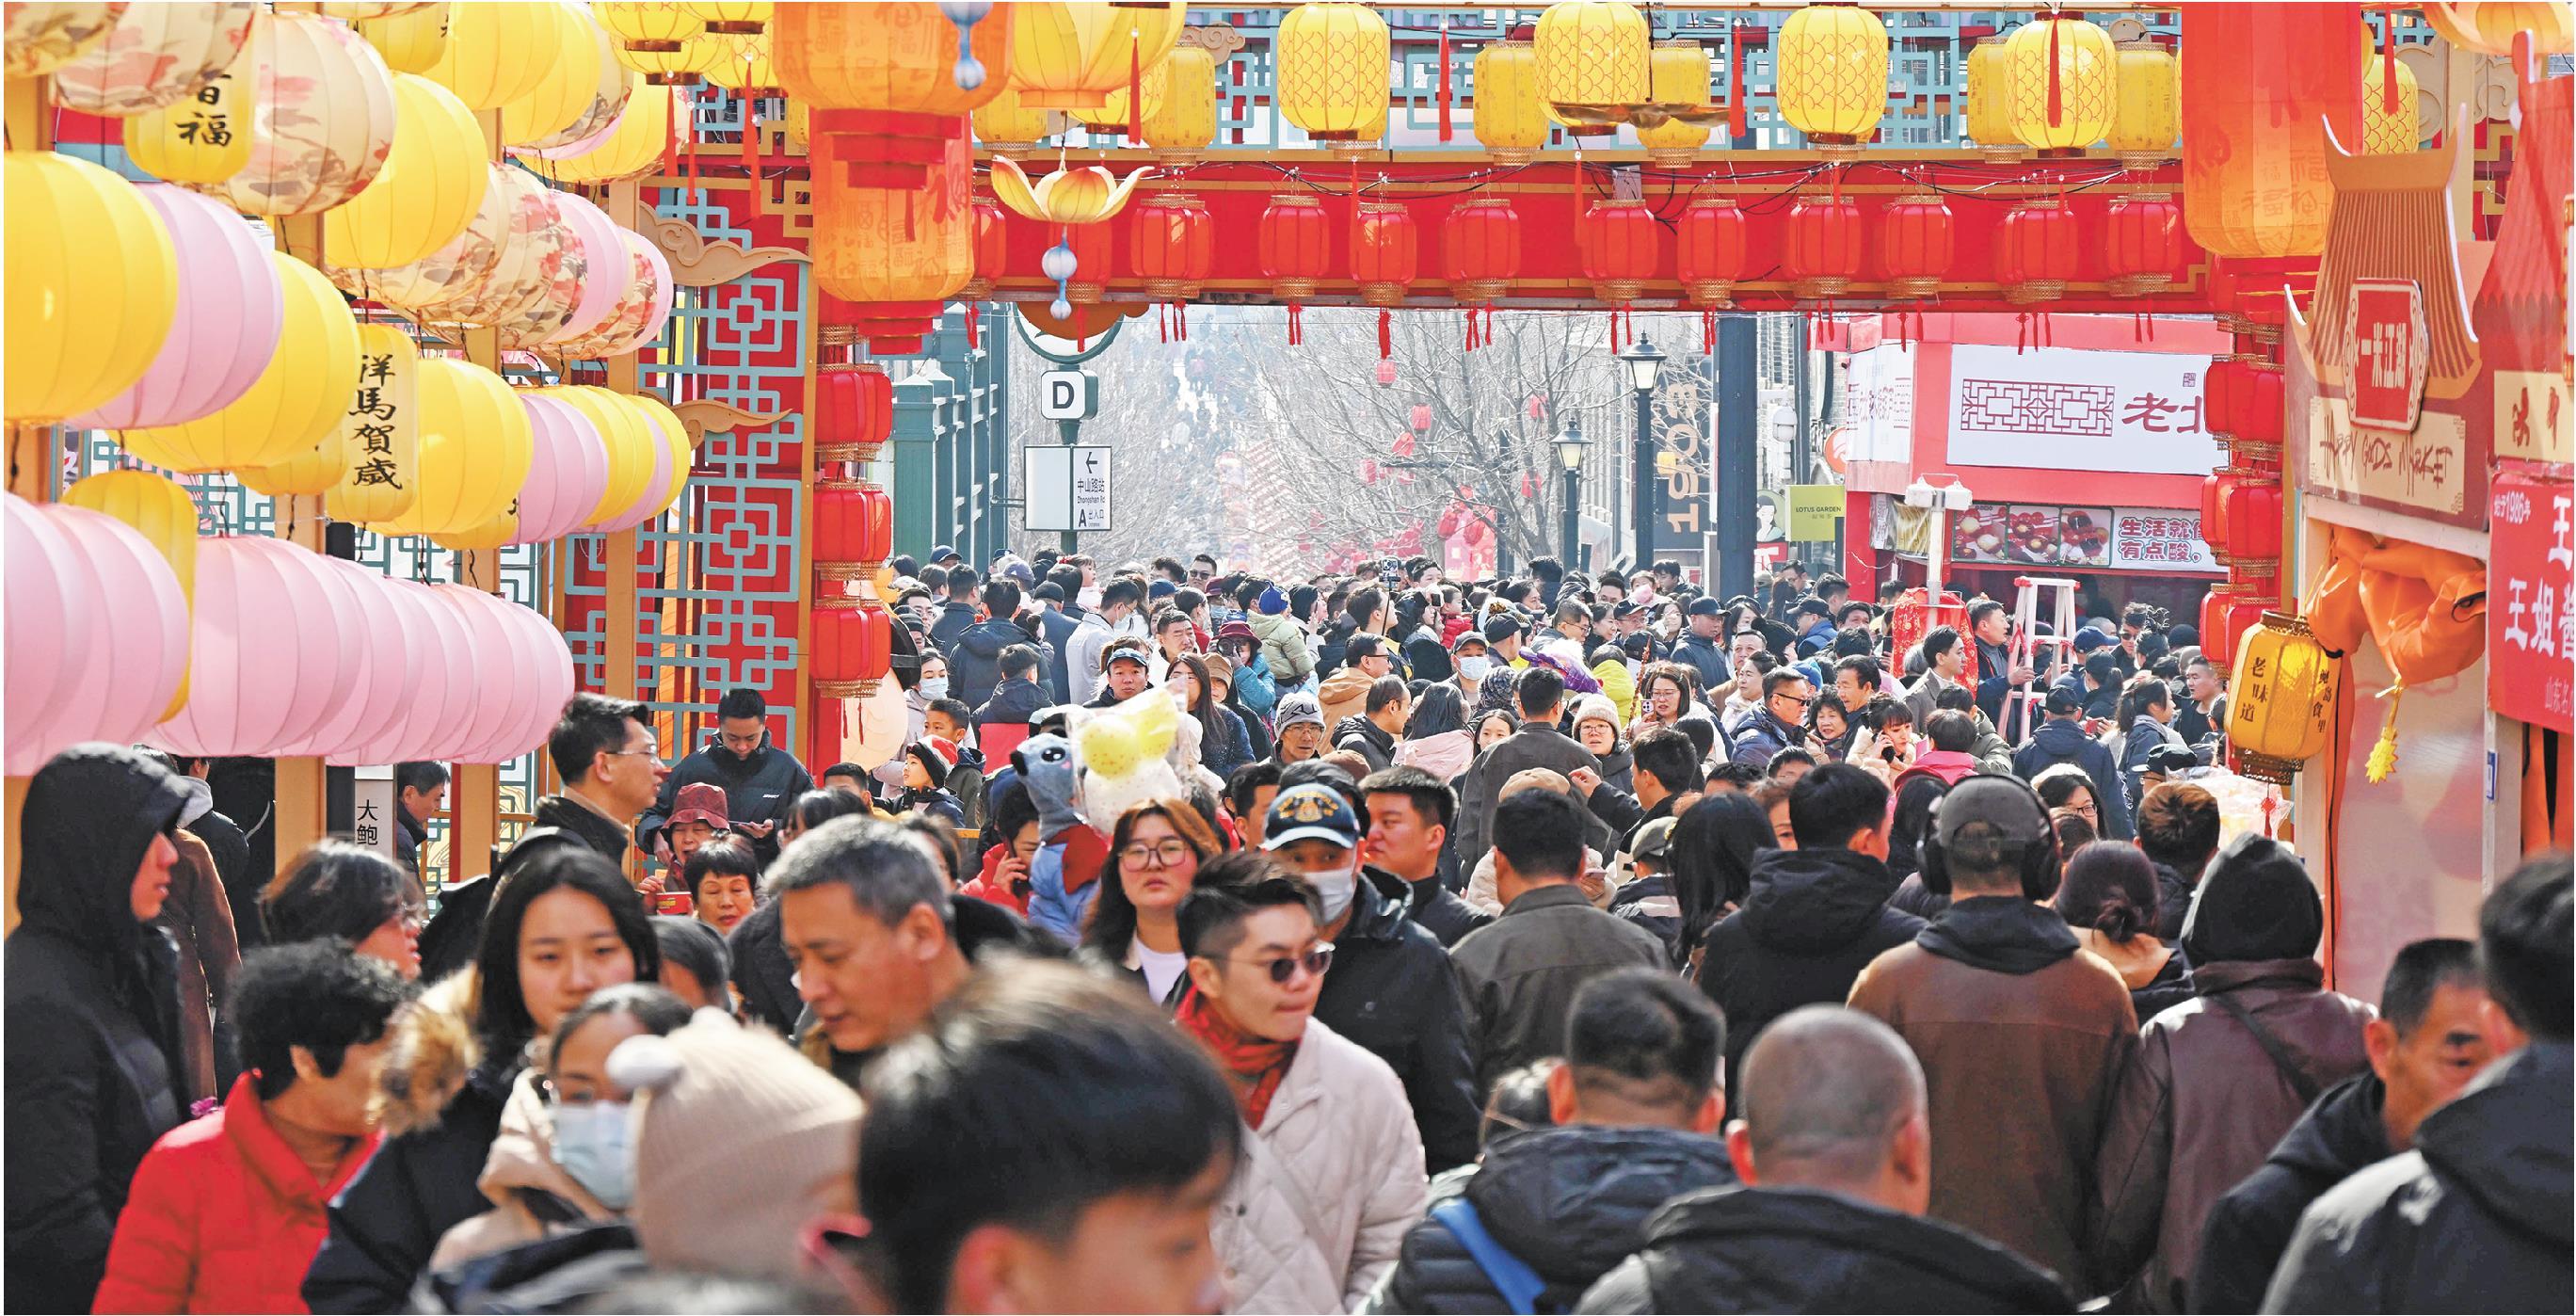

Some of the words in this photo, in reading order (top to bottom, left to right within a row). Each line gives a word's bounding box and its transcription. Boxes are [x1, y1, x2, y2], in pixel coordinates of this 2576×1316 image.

[1052, 380, 1075, 409] D
[1077, 478, 1105, 493] 中山路站
[1078, 508, 1087, 527] A
[1088, 509, 1104, 520] 出入口
[2239, 656, 2268, 723] 老味道
[357, 798, 378, 846] 大鲍
